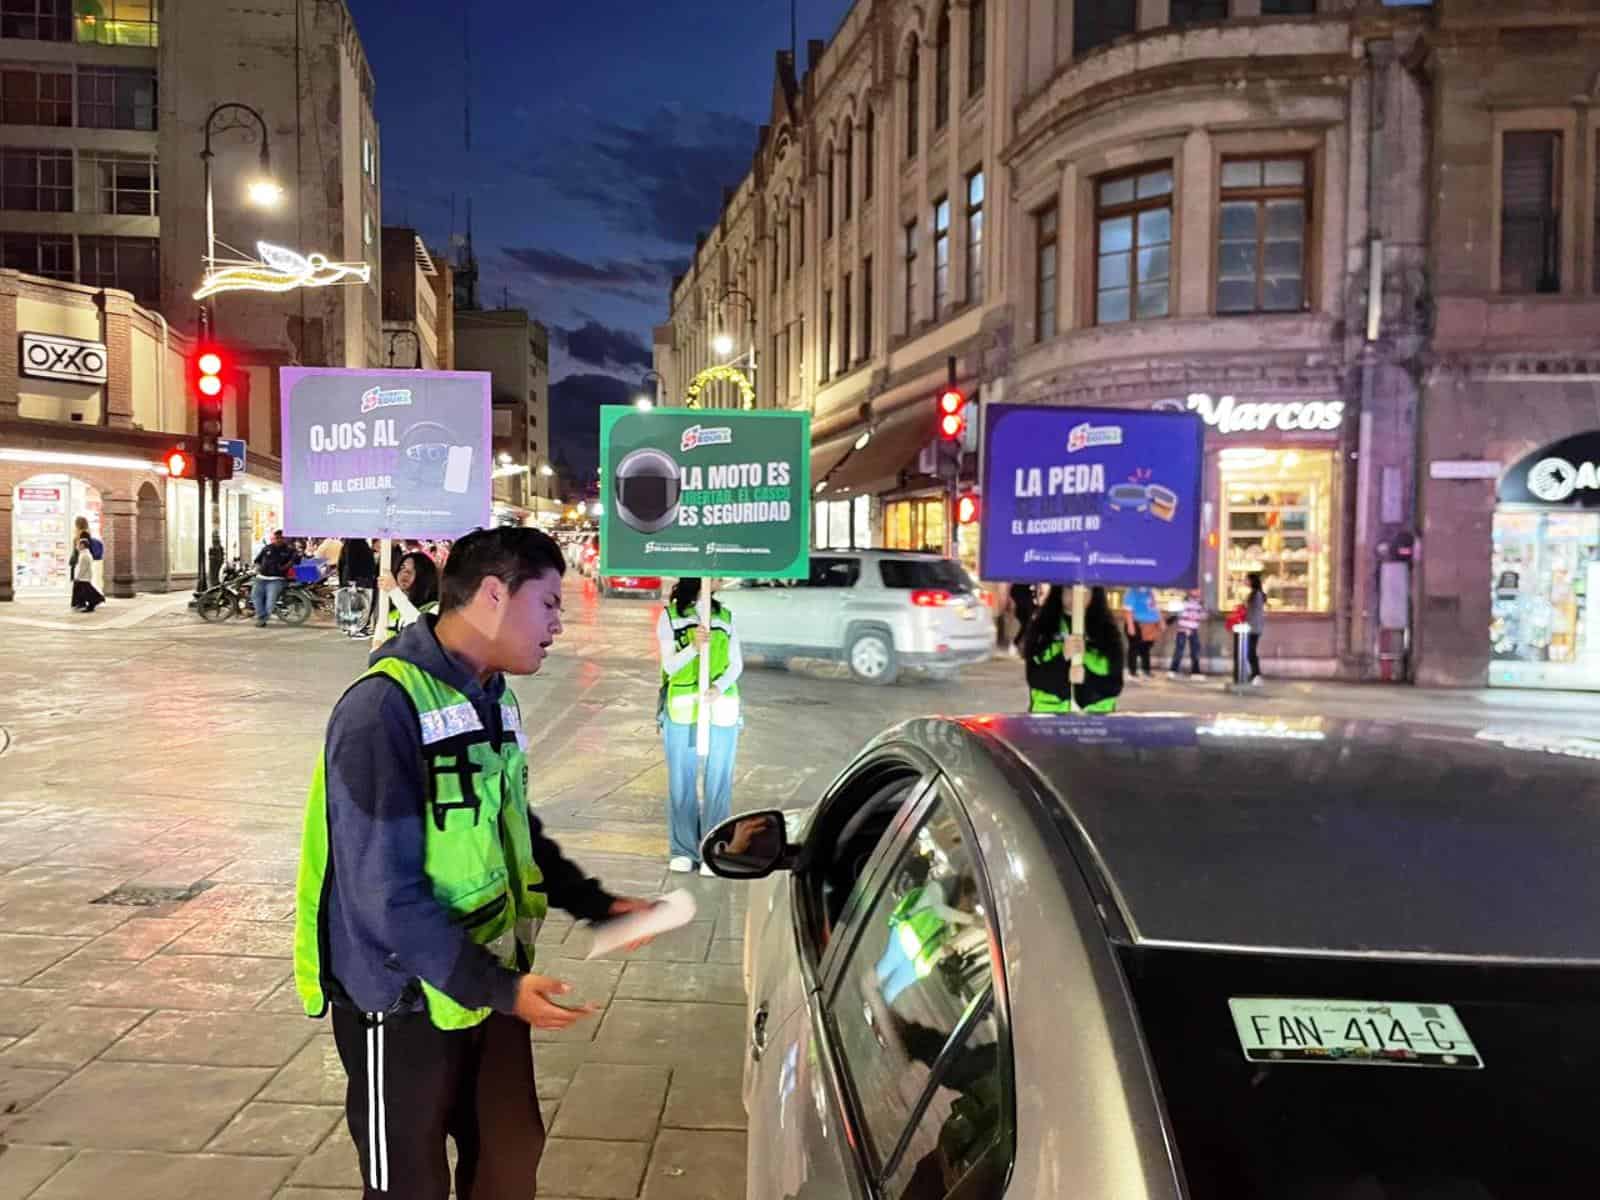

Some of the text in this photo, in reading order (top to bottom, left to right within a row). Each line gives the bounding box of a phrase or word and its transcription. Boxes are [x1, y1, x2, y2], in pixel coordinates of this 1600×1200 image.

[28, 344, 103, 371] OXXO
[309, 419, 400, 452] OJOS AL
[314, 479, 329, 495] NO
[331, 479, 345, 493] AL
[680, 461, 791, 490] LA MOTO ES
[1015, 464, 1105, 497] LA PEDA
[678, 501, 791, 526] ES SEGURIDAD
[1011, 515, 1101, 535] EL ACCIDENTE NO
[1250, 1015, 1455, 1051] FAN-414-C
